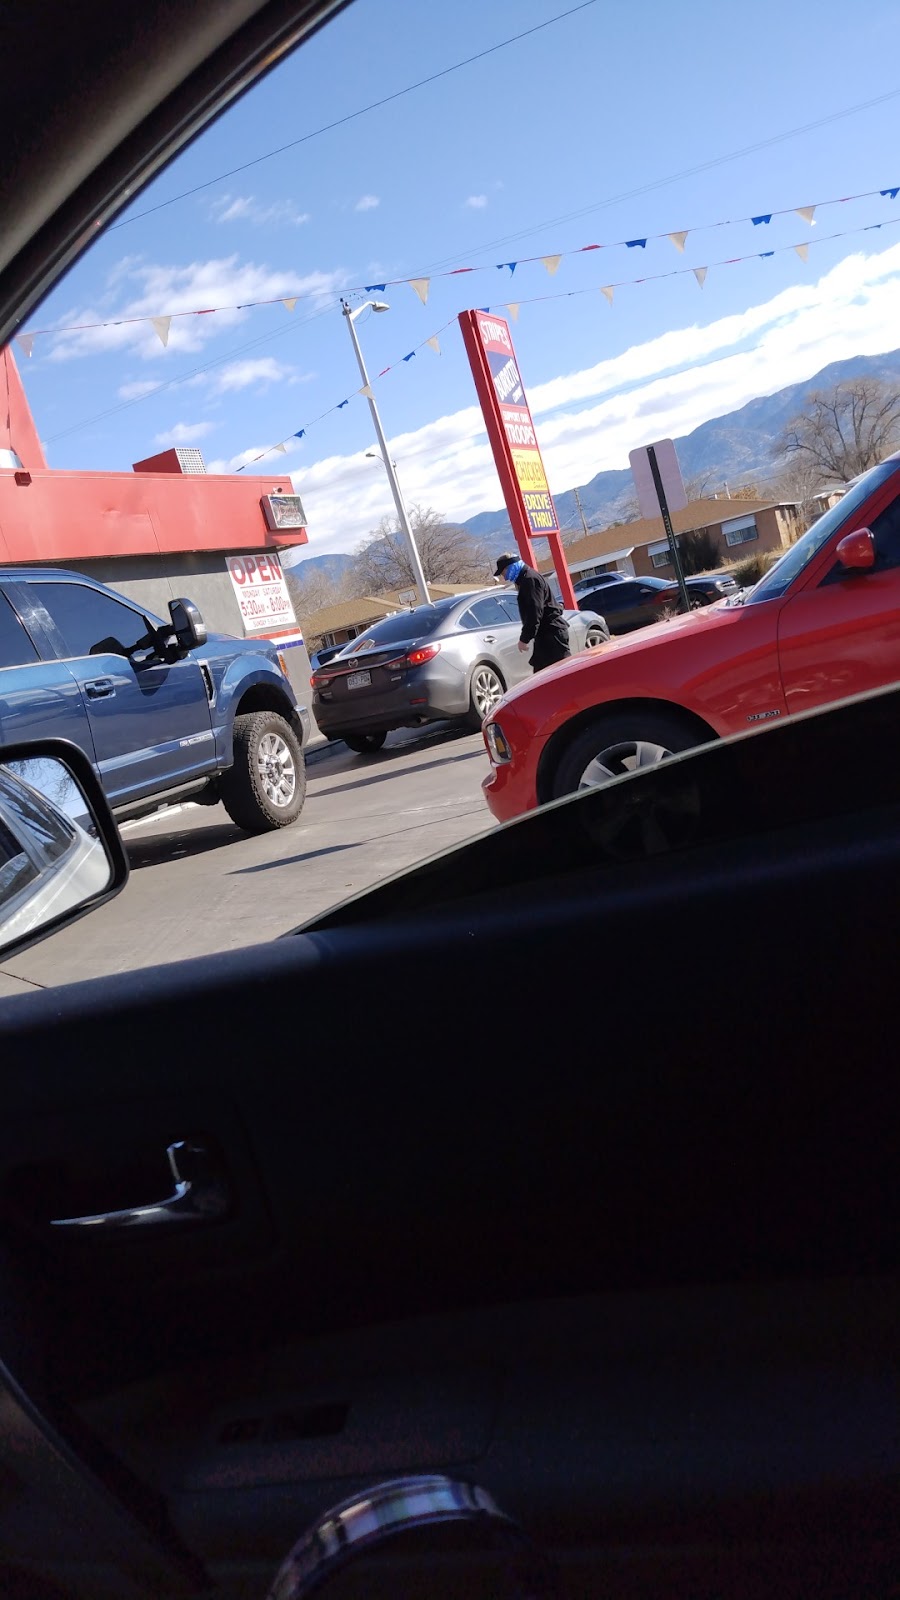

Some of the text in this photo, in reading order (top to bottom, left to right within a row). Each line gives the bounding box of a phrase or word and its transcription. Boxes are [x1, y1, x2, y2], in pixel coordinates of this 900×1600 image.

[505, 423, 535, 446] TROOPS
[515, 460, 547, 482] CHICKEN
[525, 493, 550, 510] DRIVE
[531, 511, 552, 528] THRU
[229, 555, 282, 585] OPEN
[242, 586, 282, 599] MONDAY SATURDAY
